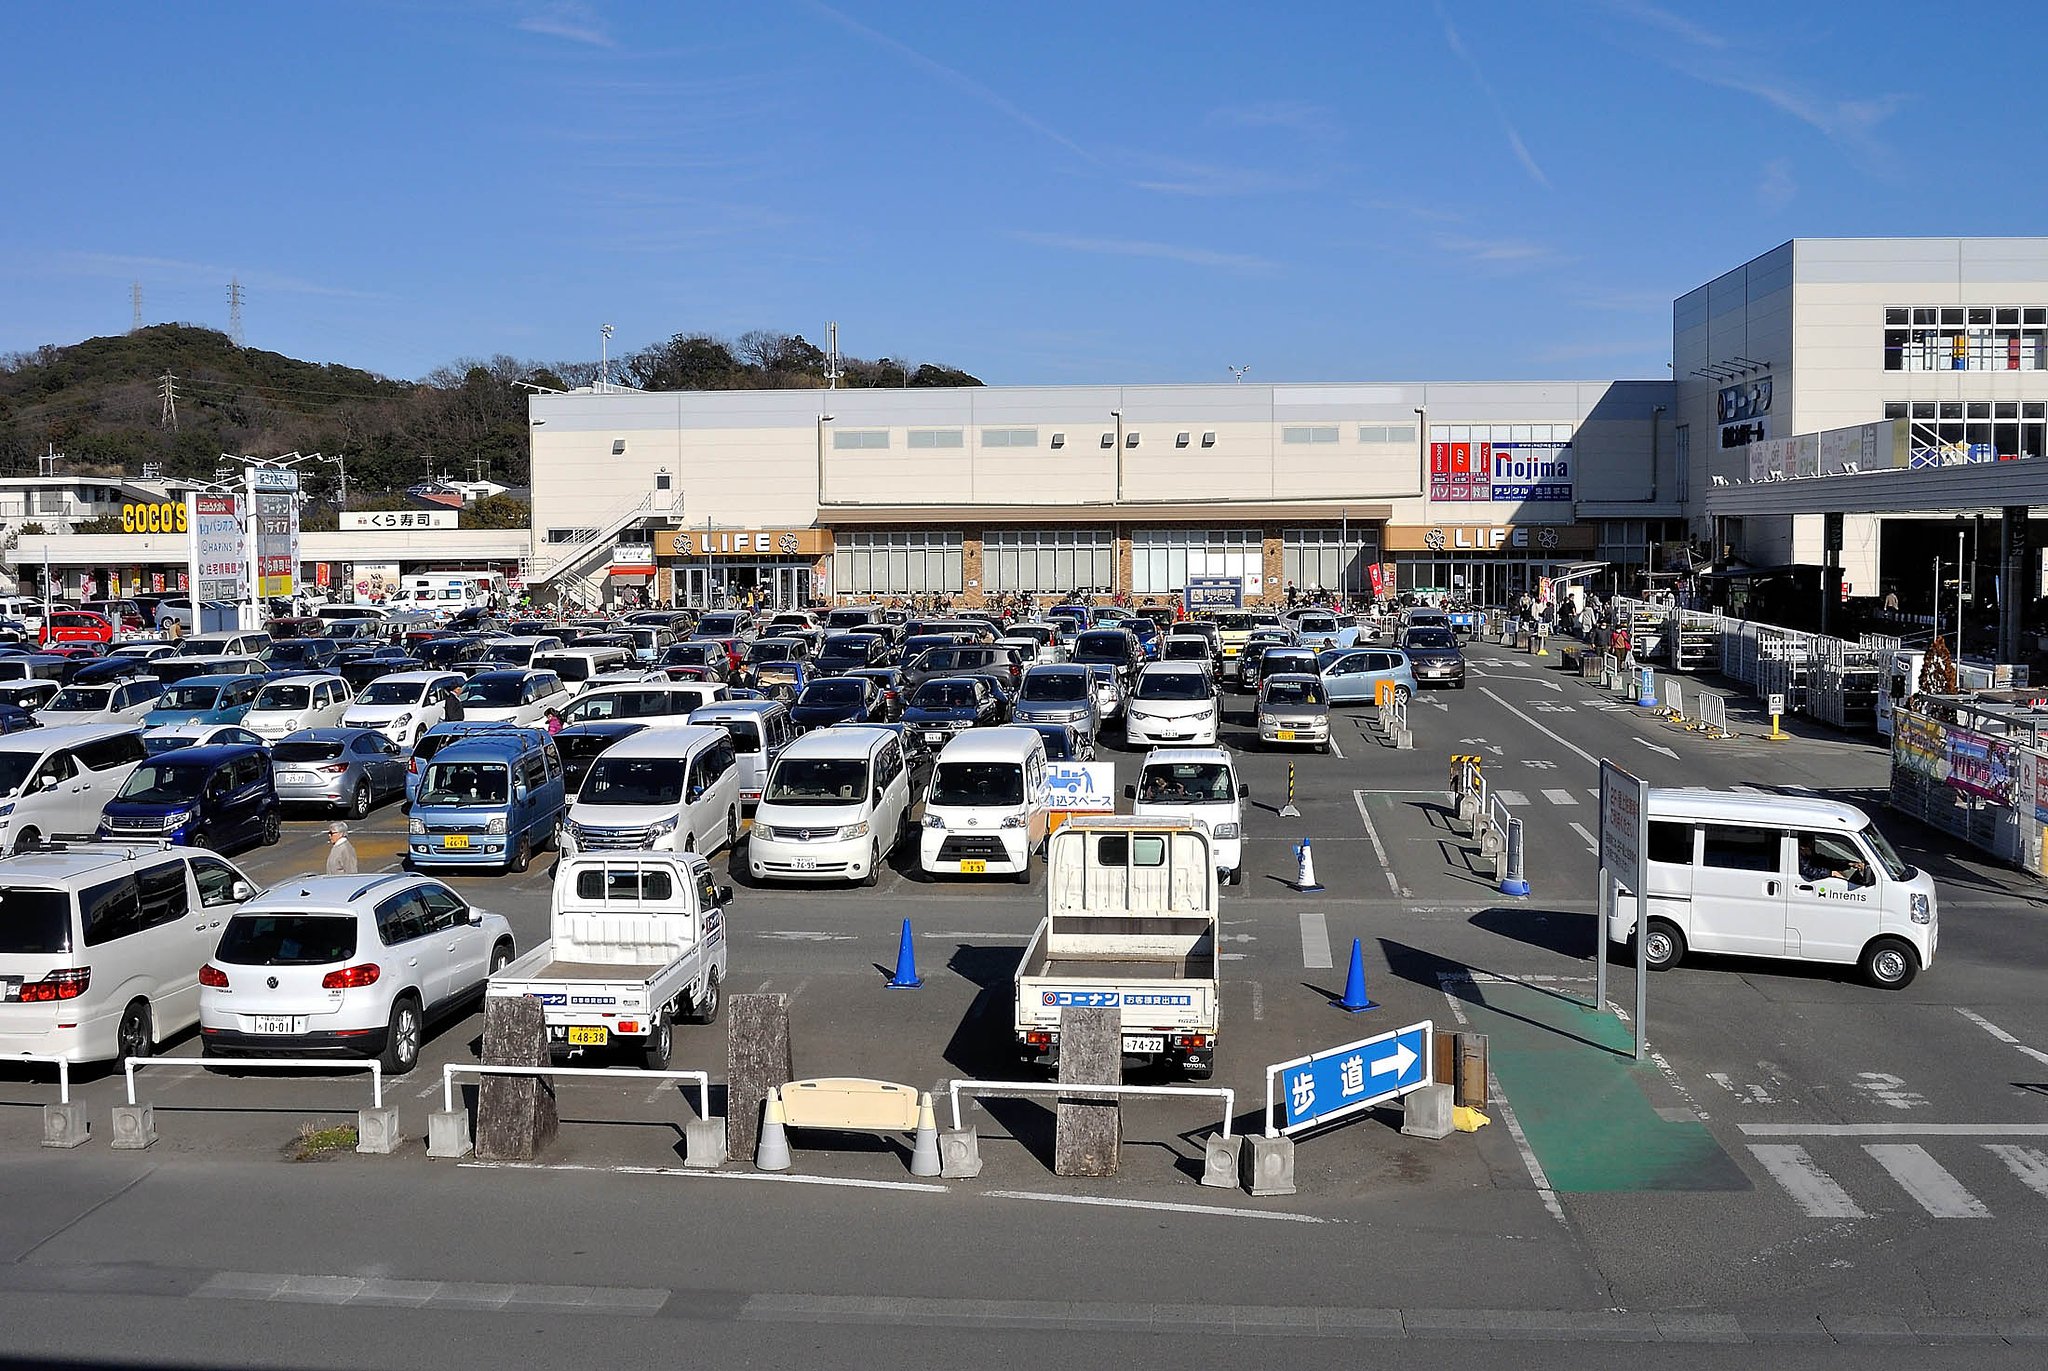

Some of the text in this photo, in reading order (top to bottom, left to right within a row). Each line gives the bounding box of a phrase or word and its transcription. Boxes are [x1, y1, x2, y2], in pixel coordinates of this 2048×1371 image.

[1457, 448, 1465, 466] au
[1495, 452, 1568, 480] nojima
[1494, 486, 1529, 495] デジタル
[262, 503, 289, 514] コーナン
[123, 501, 188, 533] COCO'S
[371, 513, 430, 527] くら寿司
[210, 520, 234, 531] パシオス
[267, 521, 288, 533] ライフ
[701, 533, 771, 552] LIFE
[1454, 528, 1529, 547] LIFE
[1829, 889, 1867, 902] Intents
[1059, 993, 1118, 1006] コーナン
[577, 1032, 605, 1043] 48-38
[1132, 1040, 1162, 1051] 74-22
[1292, 1055, 1365, 1116] 歩道
